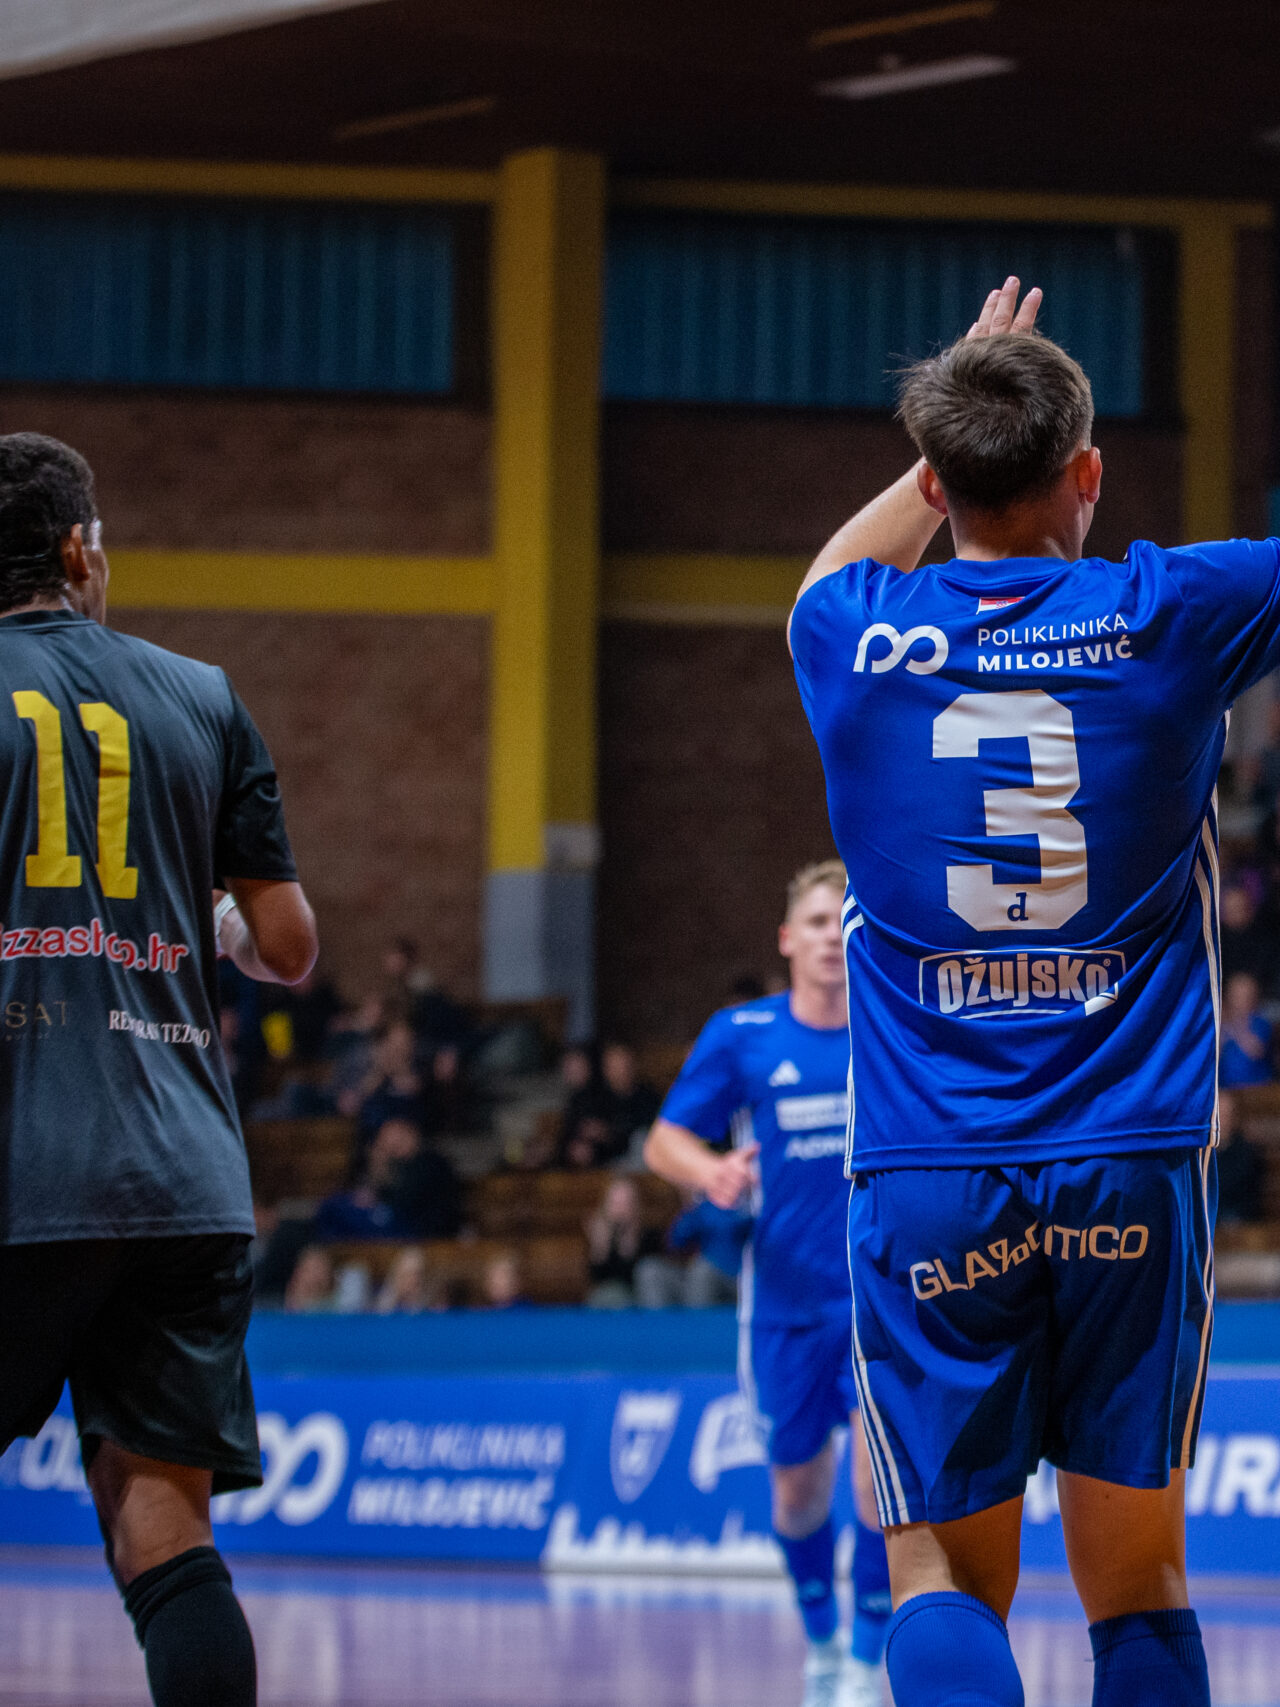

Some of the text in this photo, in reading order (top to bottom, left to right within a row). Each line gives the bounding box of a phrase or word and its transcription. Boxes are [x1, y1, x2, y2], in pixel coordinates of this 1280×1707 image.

[978, 613, 1129, 647] POLIKLINIKA
[978, 634, 1133, 673] MILOJEVIĆ
[12, 690, 138, 899] 11
[932, 688, 1088, 932] 3
[937, 953, 1109, 1014] Ožujsko
